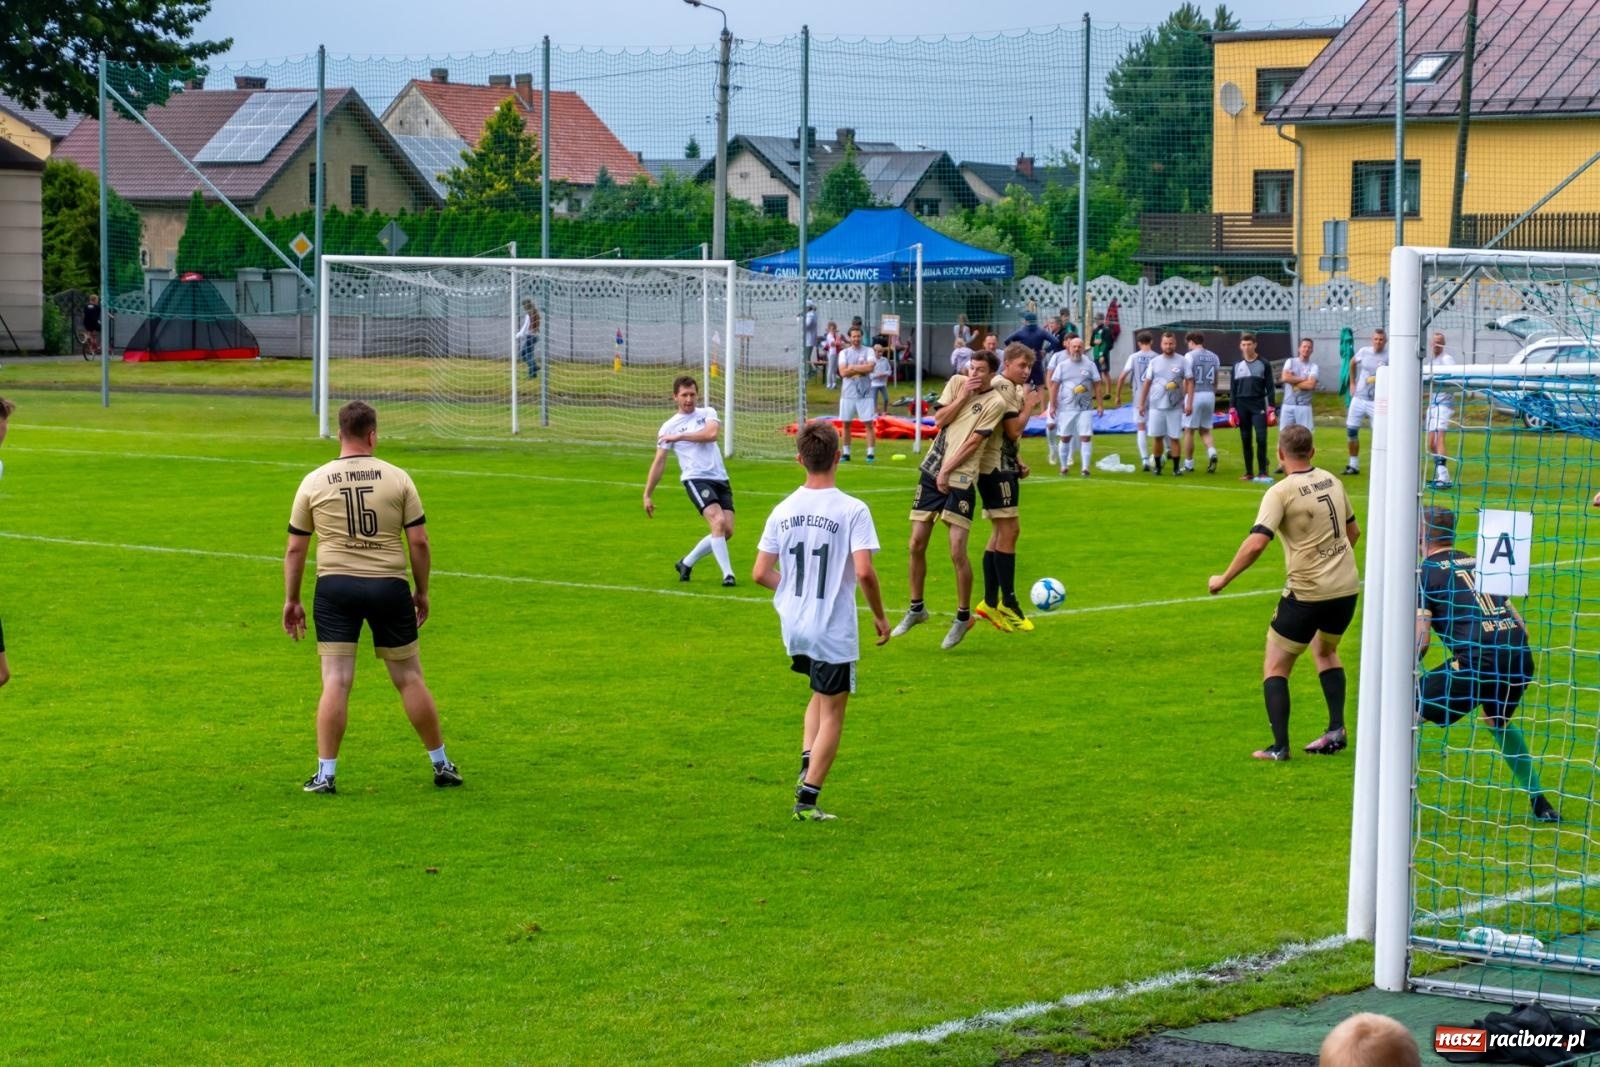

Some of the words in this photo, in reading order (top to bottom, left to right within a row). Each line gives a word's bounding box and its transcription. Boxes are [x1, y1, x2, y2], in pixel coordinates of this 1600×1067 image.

[1195, 365, 1215, 385] 14
[999, 481, 1012, 498] 10
[340, 486, 378, 539] 16
[806, 514, 840, 534] ELECTRO
[1316, 493, 1340, 539] 7
[1489, 532, 1516, 566] A
[789, 541, 829, 600] 11
